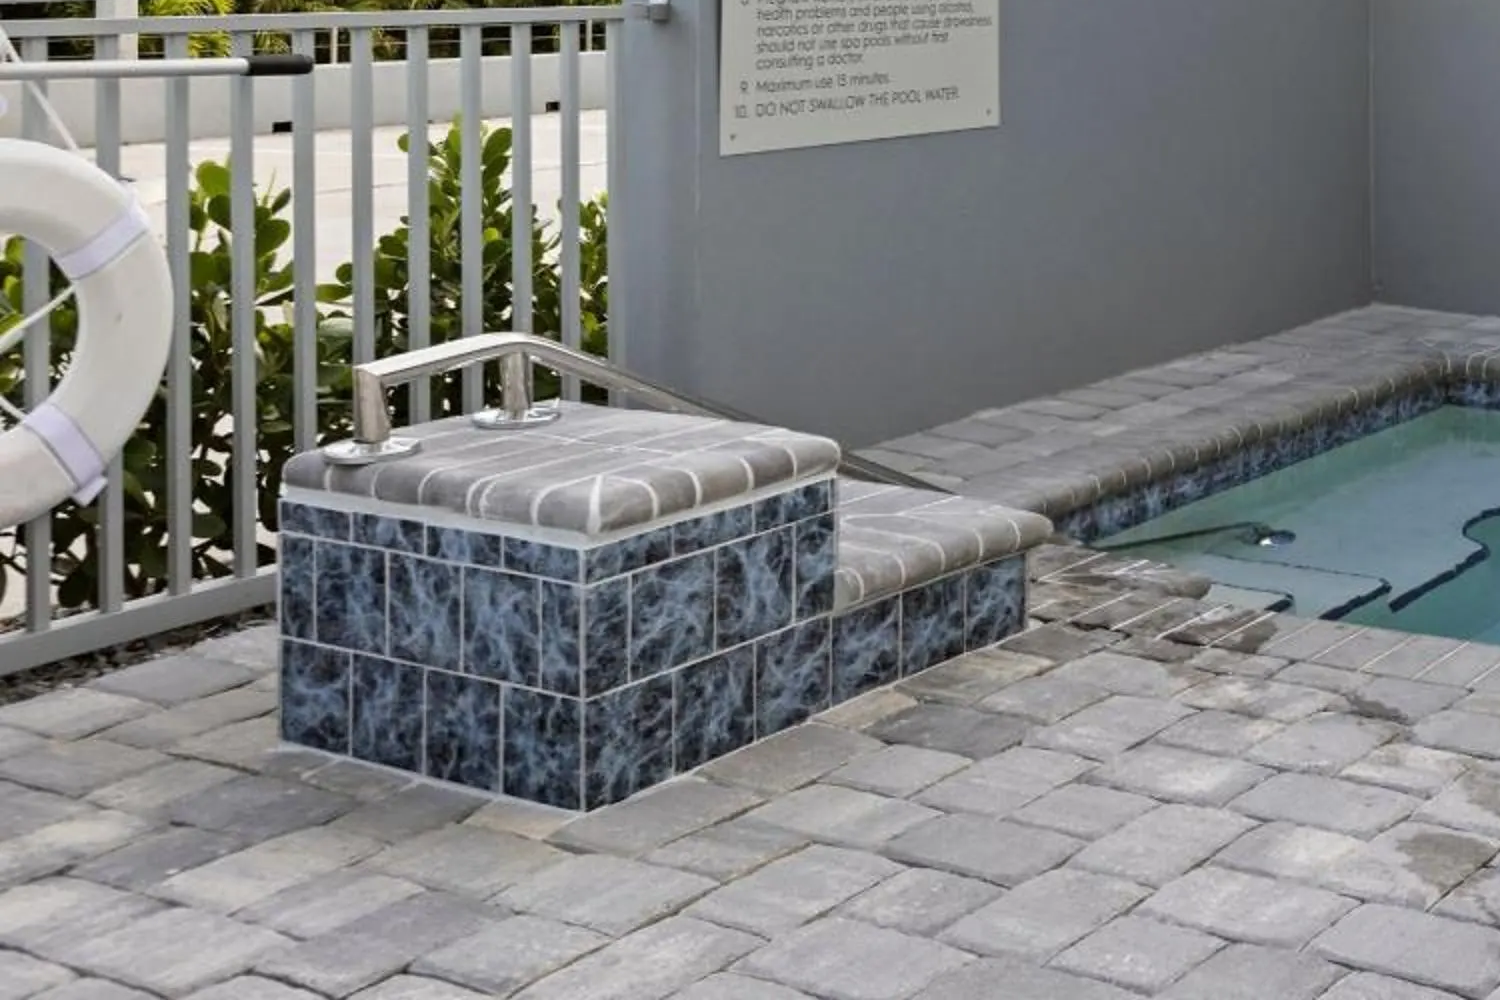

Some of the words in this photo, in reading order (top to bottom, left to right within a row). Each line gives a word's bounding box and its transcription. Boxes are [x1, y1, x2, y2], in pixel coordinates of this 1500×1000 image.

[757, 7, 793, 22] health
[795, 5, 846, 21] problems
[849, 4, 871, 18] and
[873, 3, 909, 19] people
[911, 2, 936, 18] using
[757, 23, 809, 38] narcotics
[811, 22, 824, 36] or
[826, 20, 856, 35] other
[858, 18, 888, 35] drugs
[890, 17, 910, 31] that
[912, 17, 941, 31] cause
[756, 38, 795, 55] should
[797, 38, 816, 53] not
[819, 38, 838, 51] use
[841, 37, 860, 52] spa
[863, 34, 892, 51] pools
[894, 31, 929, 47] without
[931, 29, 949, 44] first
[755, 53, 813, 72] consulting
[817, 54, 825, 67] a
[755, 77, 813, 94] Maximum
[815, 75, 833, 90] use
[755, 102, 777, 118] DO
[780, 99, 805, 117] NOT
[808, 94, 865, 114] SWALLOW
[869, 90, 889, 107] THE
[891, 88, 922, 105] POOL
